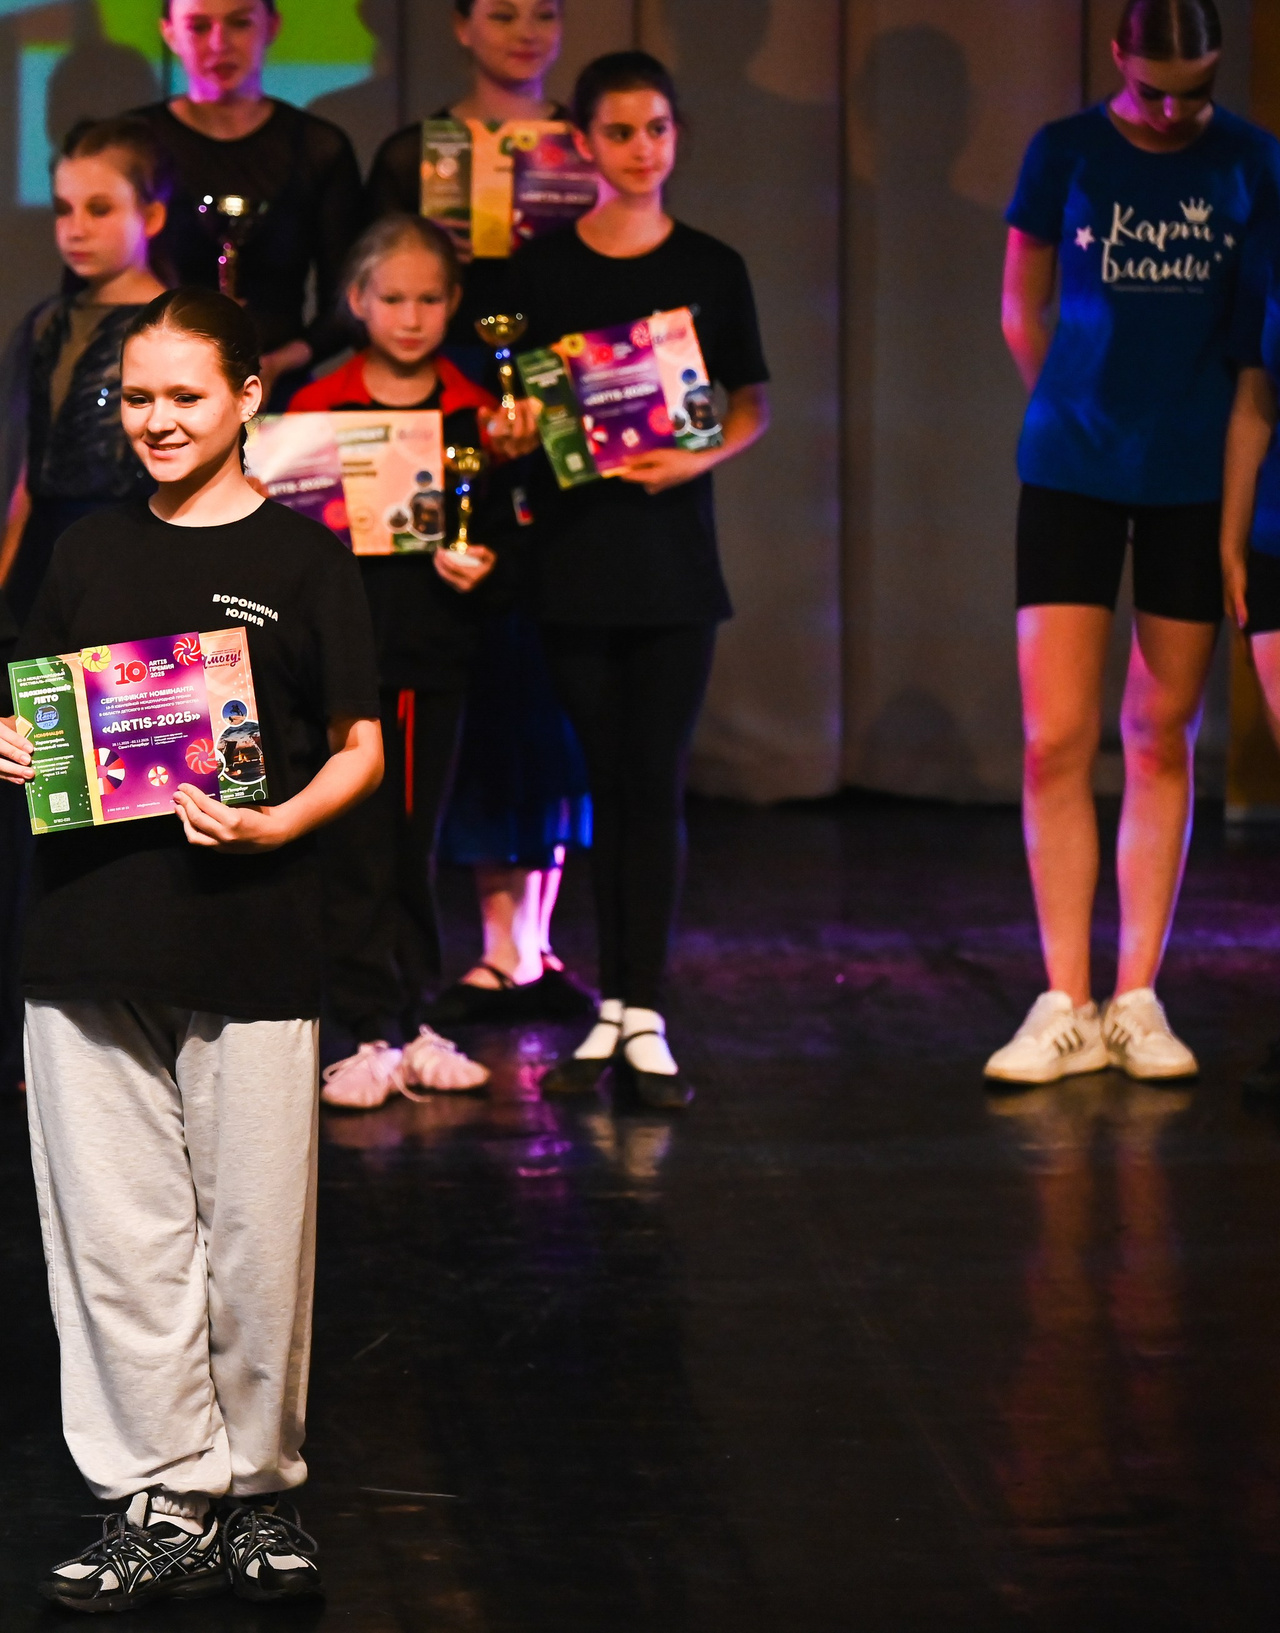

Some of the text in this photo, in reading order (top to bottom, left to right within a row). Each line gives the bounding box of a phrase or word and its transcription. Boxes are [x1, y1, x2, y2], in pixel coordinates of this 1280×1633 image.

[1109, 201, 1213, 252] Карт
[212, 593, 279, 622] ВОРОНИНА
[225, 607, 265, 627] ЮЛИЯ
[148, 659, 167, 667] ARTIS
[149, 663, 174, 672] ПРЕМИЯ
[207, 649, 241, 667] могу!
[114, 660, 148, 685] 10
[33, 694, 59, 705] ЛЕТО
[100, 686, 195, 705] СЕРТИФИКАТ НОМИНАНТА
[102, 710, 201, 734] «ARTIS-2025»
